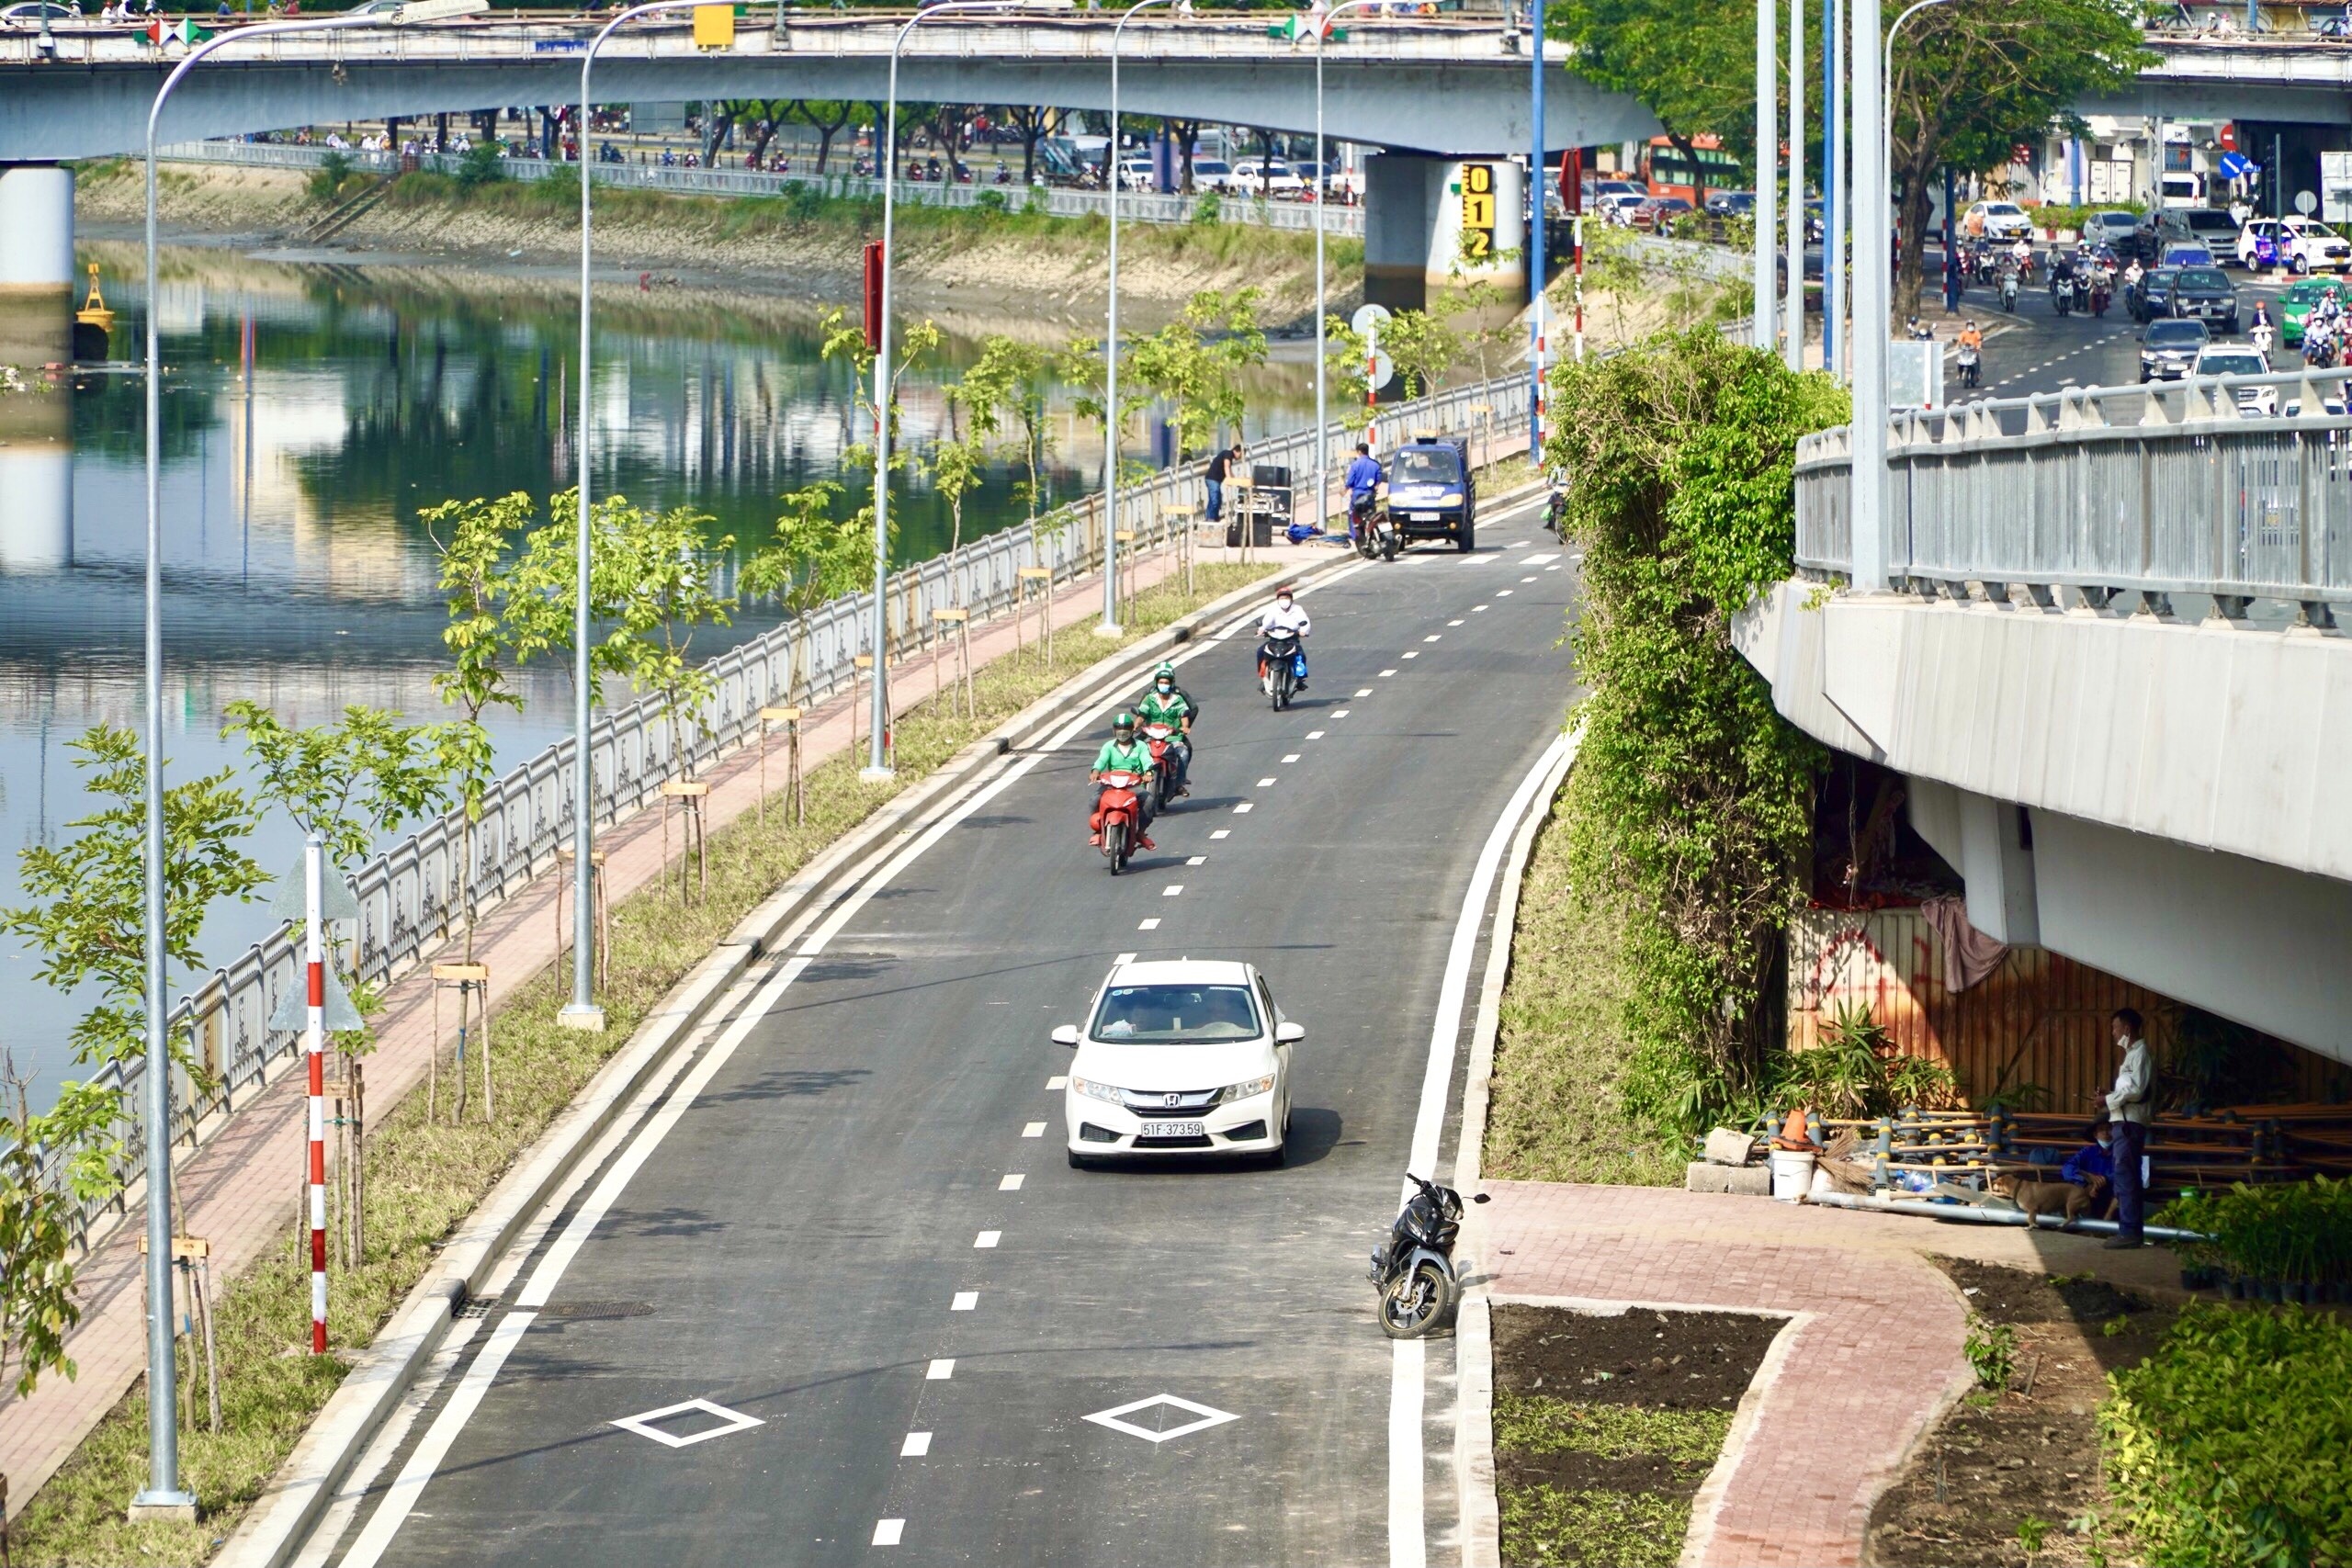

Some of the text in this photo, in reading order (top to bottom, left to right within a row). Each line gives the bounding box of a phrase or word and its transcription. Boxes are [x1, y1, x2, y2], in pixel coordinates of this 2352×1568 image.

[1471, 167, 1488, 192] 0
[1473, 201, 1482, 222] 1
[1472, 231, 1489, 255] 2
